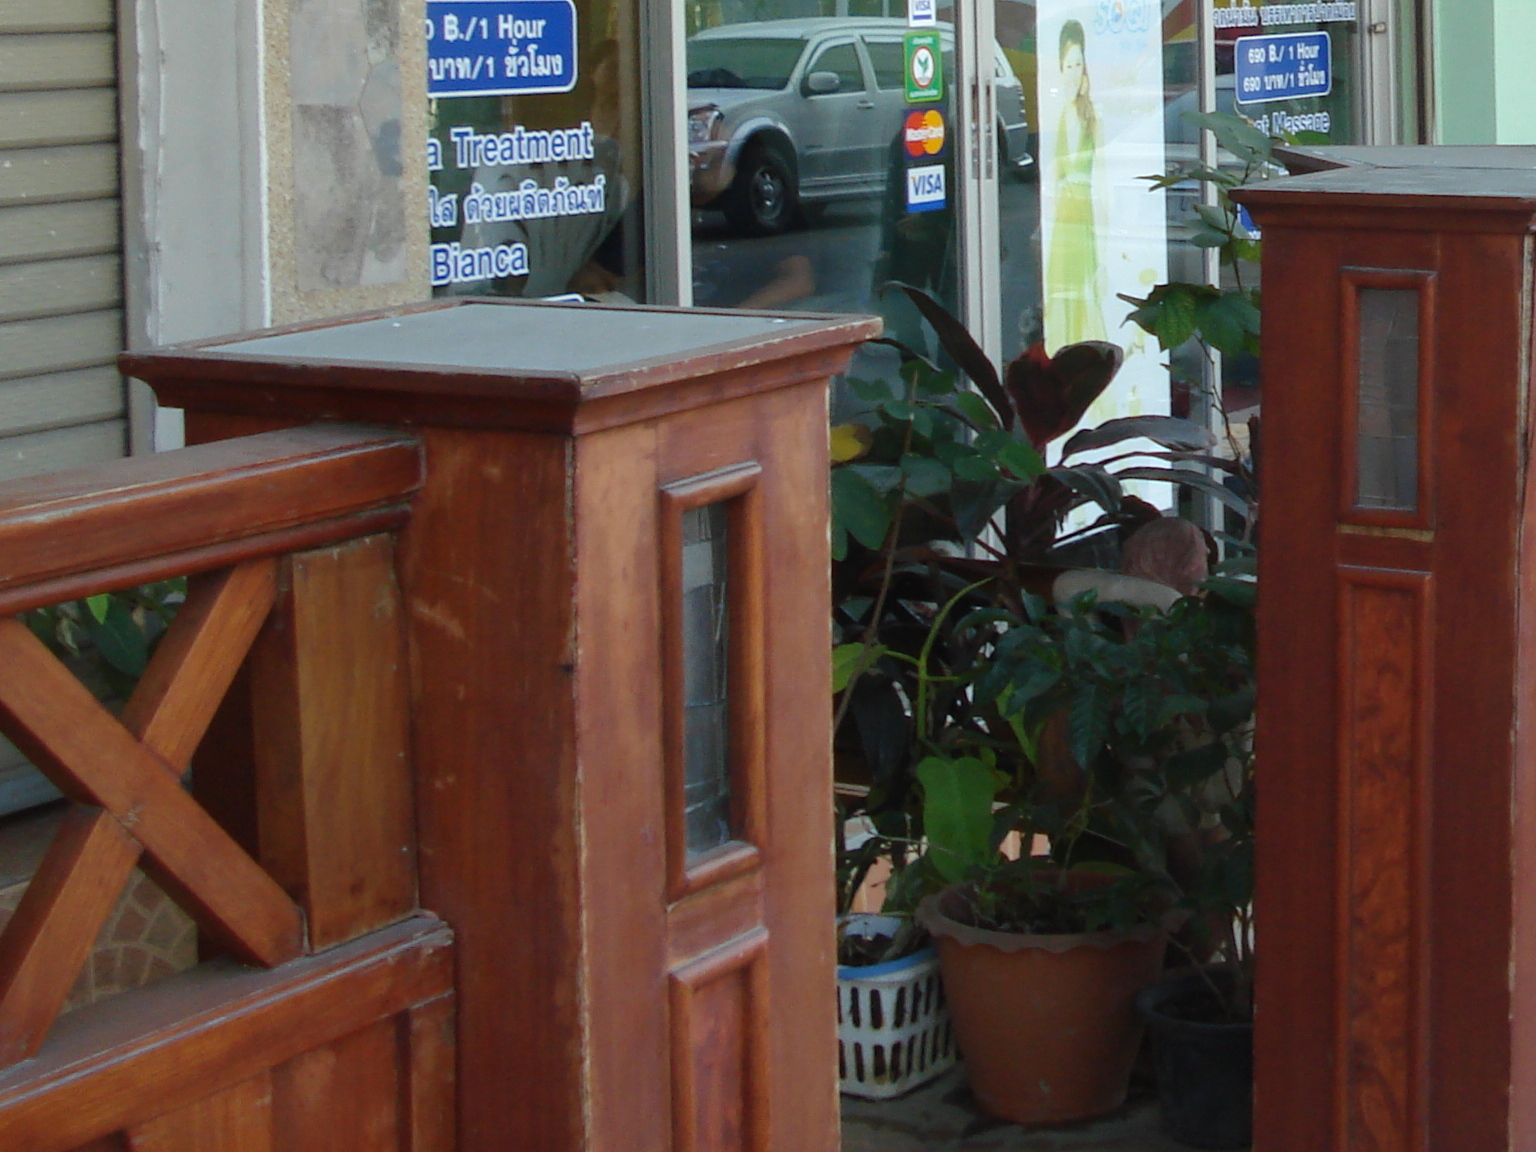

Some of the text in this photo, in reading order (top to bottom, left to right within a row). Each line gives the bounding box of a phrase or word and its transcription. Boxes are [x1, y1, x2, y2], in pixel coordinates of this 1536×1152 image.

[498, 13, 547, 40] Hour
[429, 38, 562, 81] บาท/1 ชั่วโมง
[1297, 42, 1320, 59] Hour
[450, 121, 594, 169] Treatment
[463, 174, 606, 225] ด้วยผลิตภัณฑ์
[911, 174, 943, 196] VISA
[430, 242, 530, 287] Bianca
